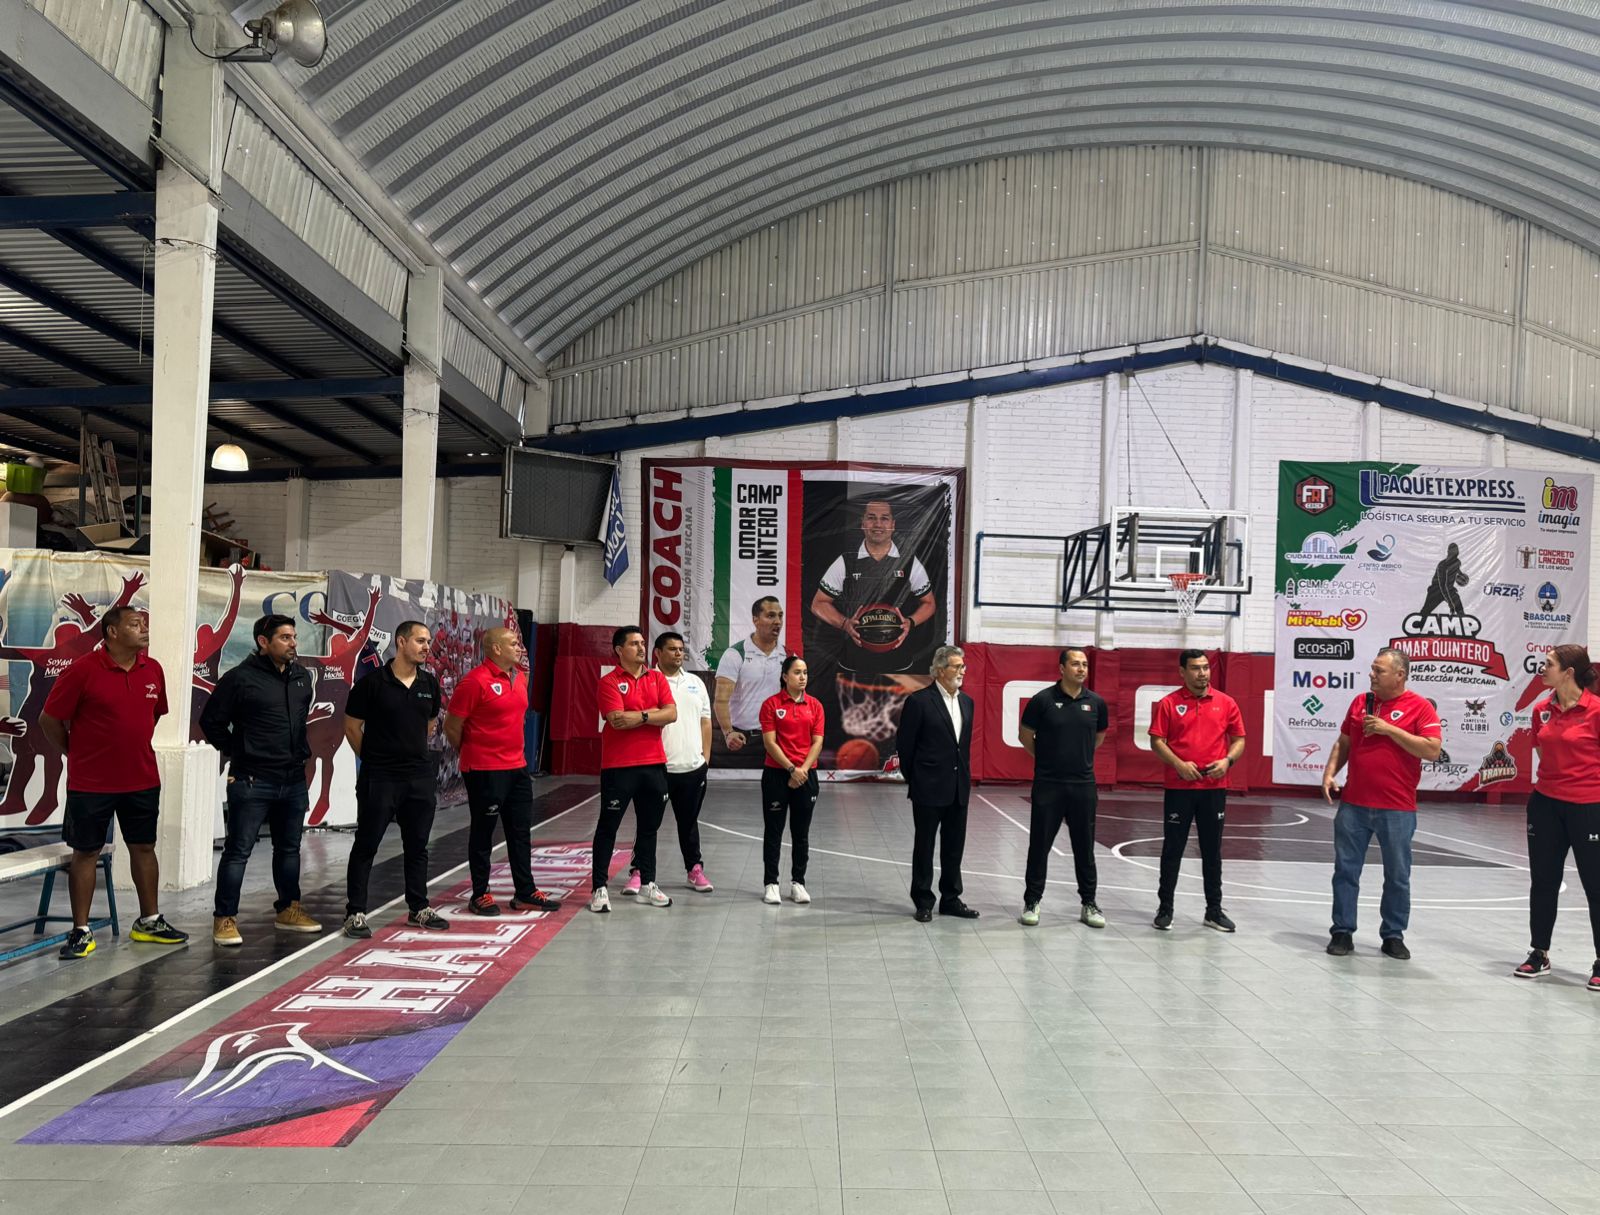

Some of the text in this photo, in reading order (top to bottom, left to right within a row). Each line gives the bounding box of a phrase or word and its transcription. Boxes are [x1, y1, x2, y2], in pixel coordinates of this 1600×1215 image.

[737, 484, 782, 504] CAMP
[1380, 475, 1515, 499] PAQUETEXPRESS
[1361, 510, 1526, 527] LOGÍSTICA SEGURA A TU SERVICIO
[1537, 510, 1580, 529] imagia
[684, 507, 693, 565] MEXICANA
[739, 507, 756, 559] OMAR
[652, 467, 682, 626] COACH
[757, 507, 779, 586] QUINTERO
[1538, 549, 1574, 558] CONCRETO
[1538, 557, 1570, 565] LANZADO
[682, 569, 692, 629] SELECCIÓN
[862, 614, 897, 625] SPALDING
[1287, 616, 1302, 626] Mi
[1404, 614, 1479, 636] CAMP
[1529, 613, 1566, 622] BASCLAR
[1432, 641, 1490, 662] QUINTERO
[1526, 642, 1553, 654] Grup
[1410, 664, 1474, 675] HEAD COACH
[1293, 671, 1354, 689] Mobil
[1411, 674, 1497, 685] SELECCIÓN MEXICANA
[1289, 718, 1337, 727] RefriObras
